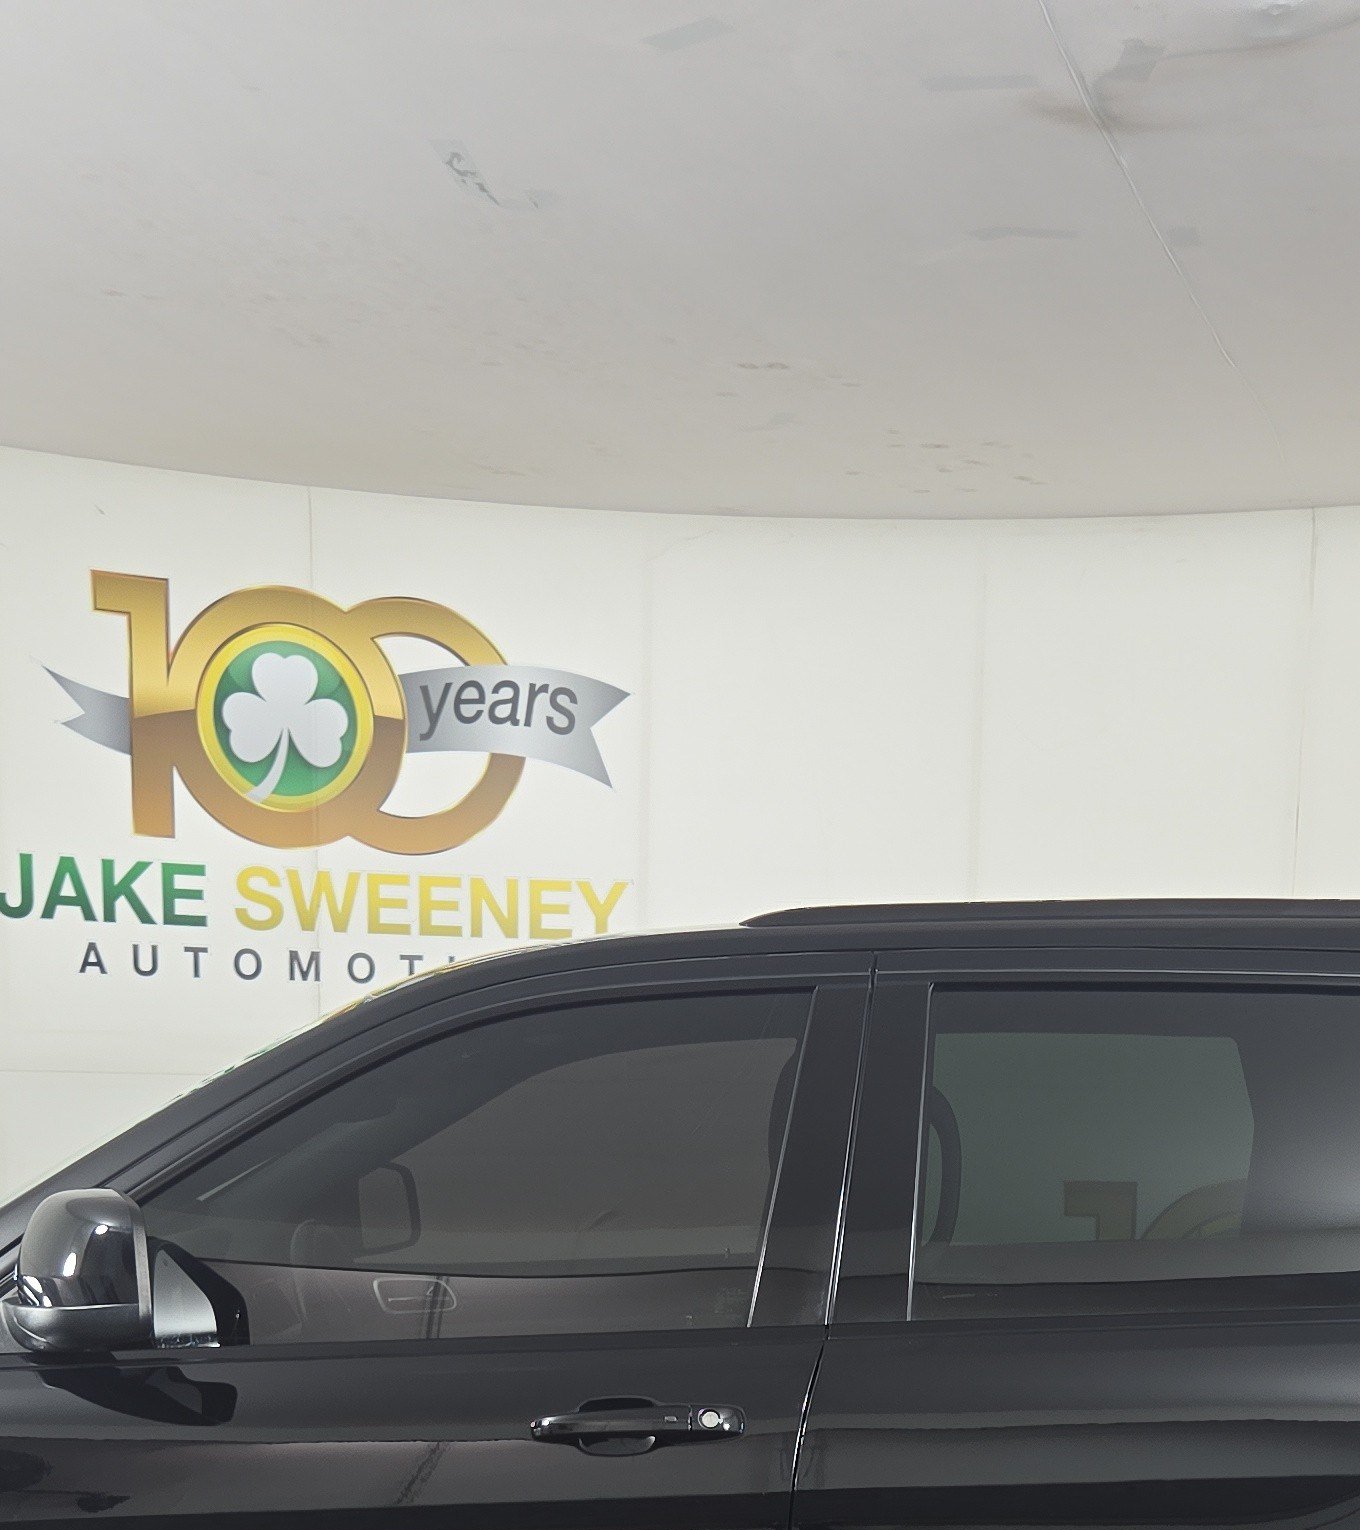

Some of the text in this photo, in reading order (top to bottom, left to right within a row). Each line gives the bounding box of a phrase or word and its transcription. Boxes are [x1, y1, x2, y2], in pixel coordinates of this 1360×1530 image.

[90, 569, 578, 856] 100 years
[234, 865, 630, 940] SWEENEY
[78, 941, 456, 984] AUTOMOT
